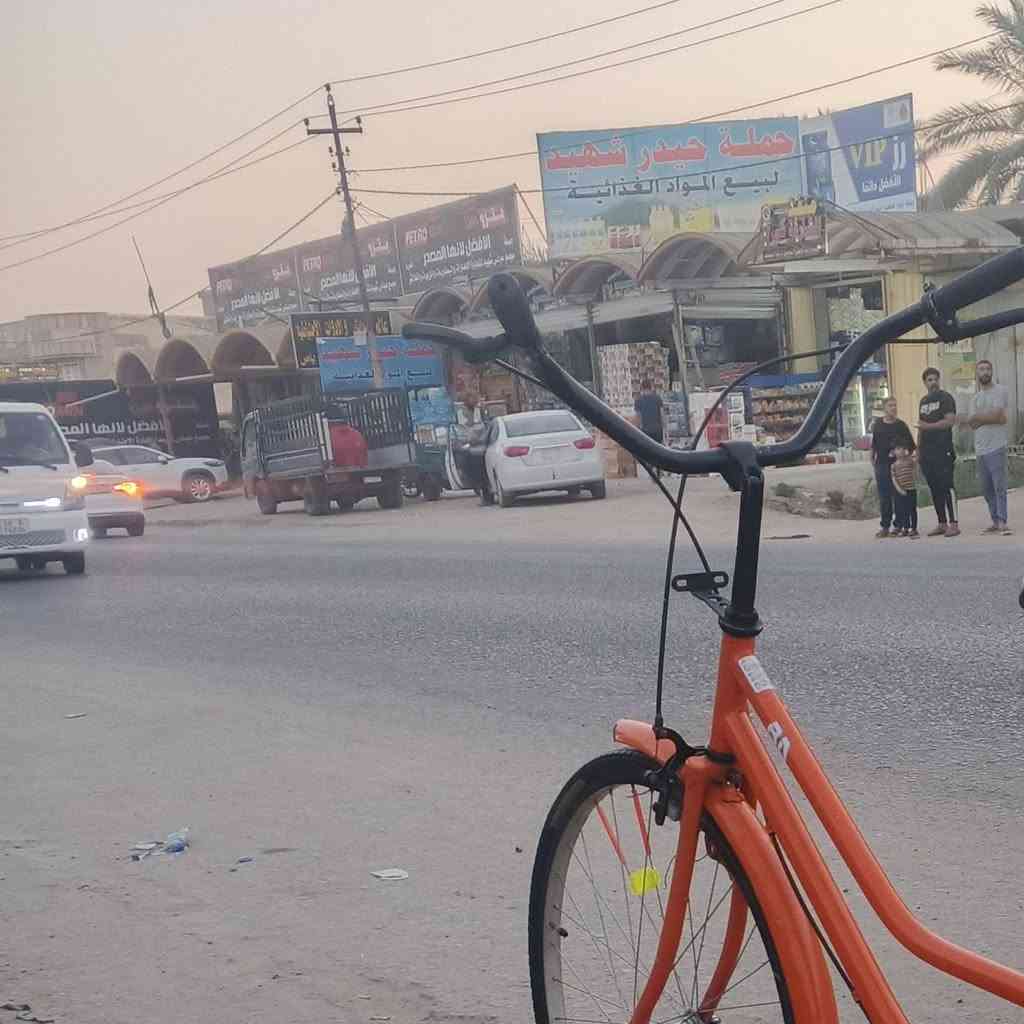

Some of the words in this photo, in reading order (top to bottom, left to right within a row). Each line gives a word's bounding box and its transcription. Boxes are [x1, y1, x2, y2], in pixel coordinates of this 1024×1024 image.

[850, 137, 888, 168] VIP
[666, 175, 716, 197] المواد
[722, 170, 779, 197] لبيع
